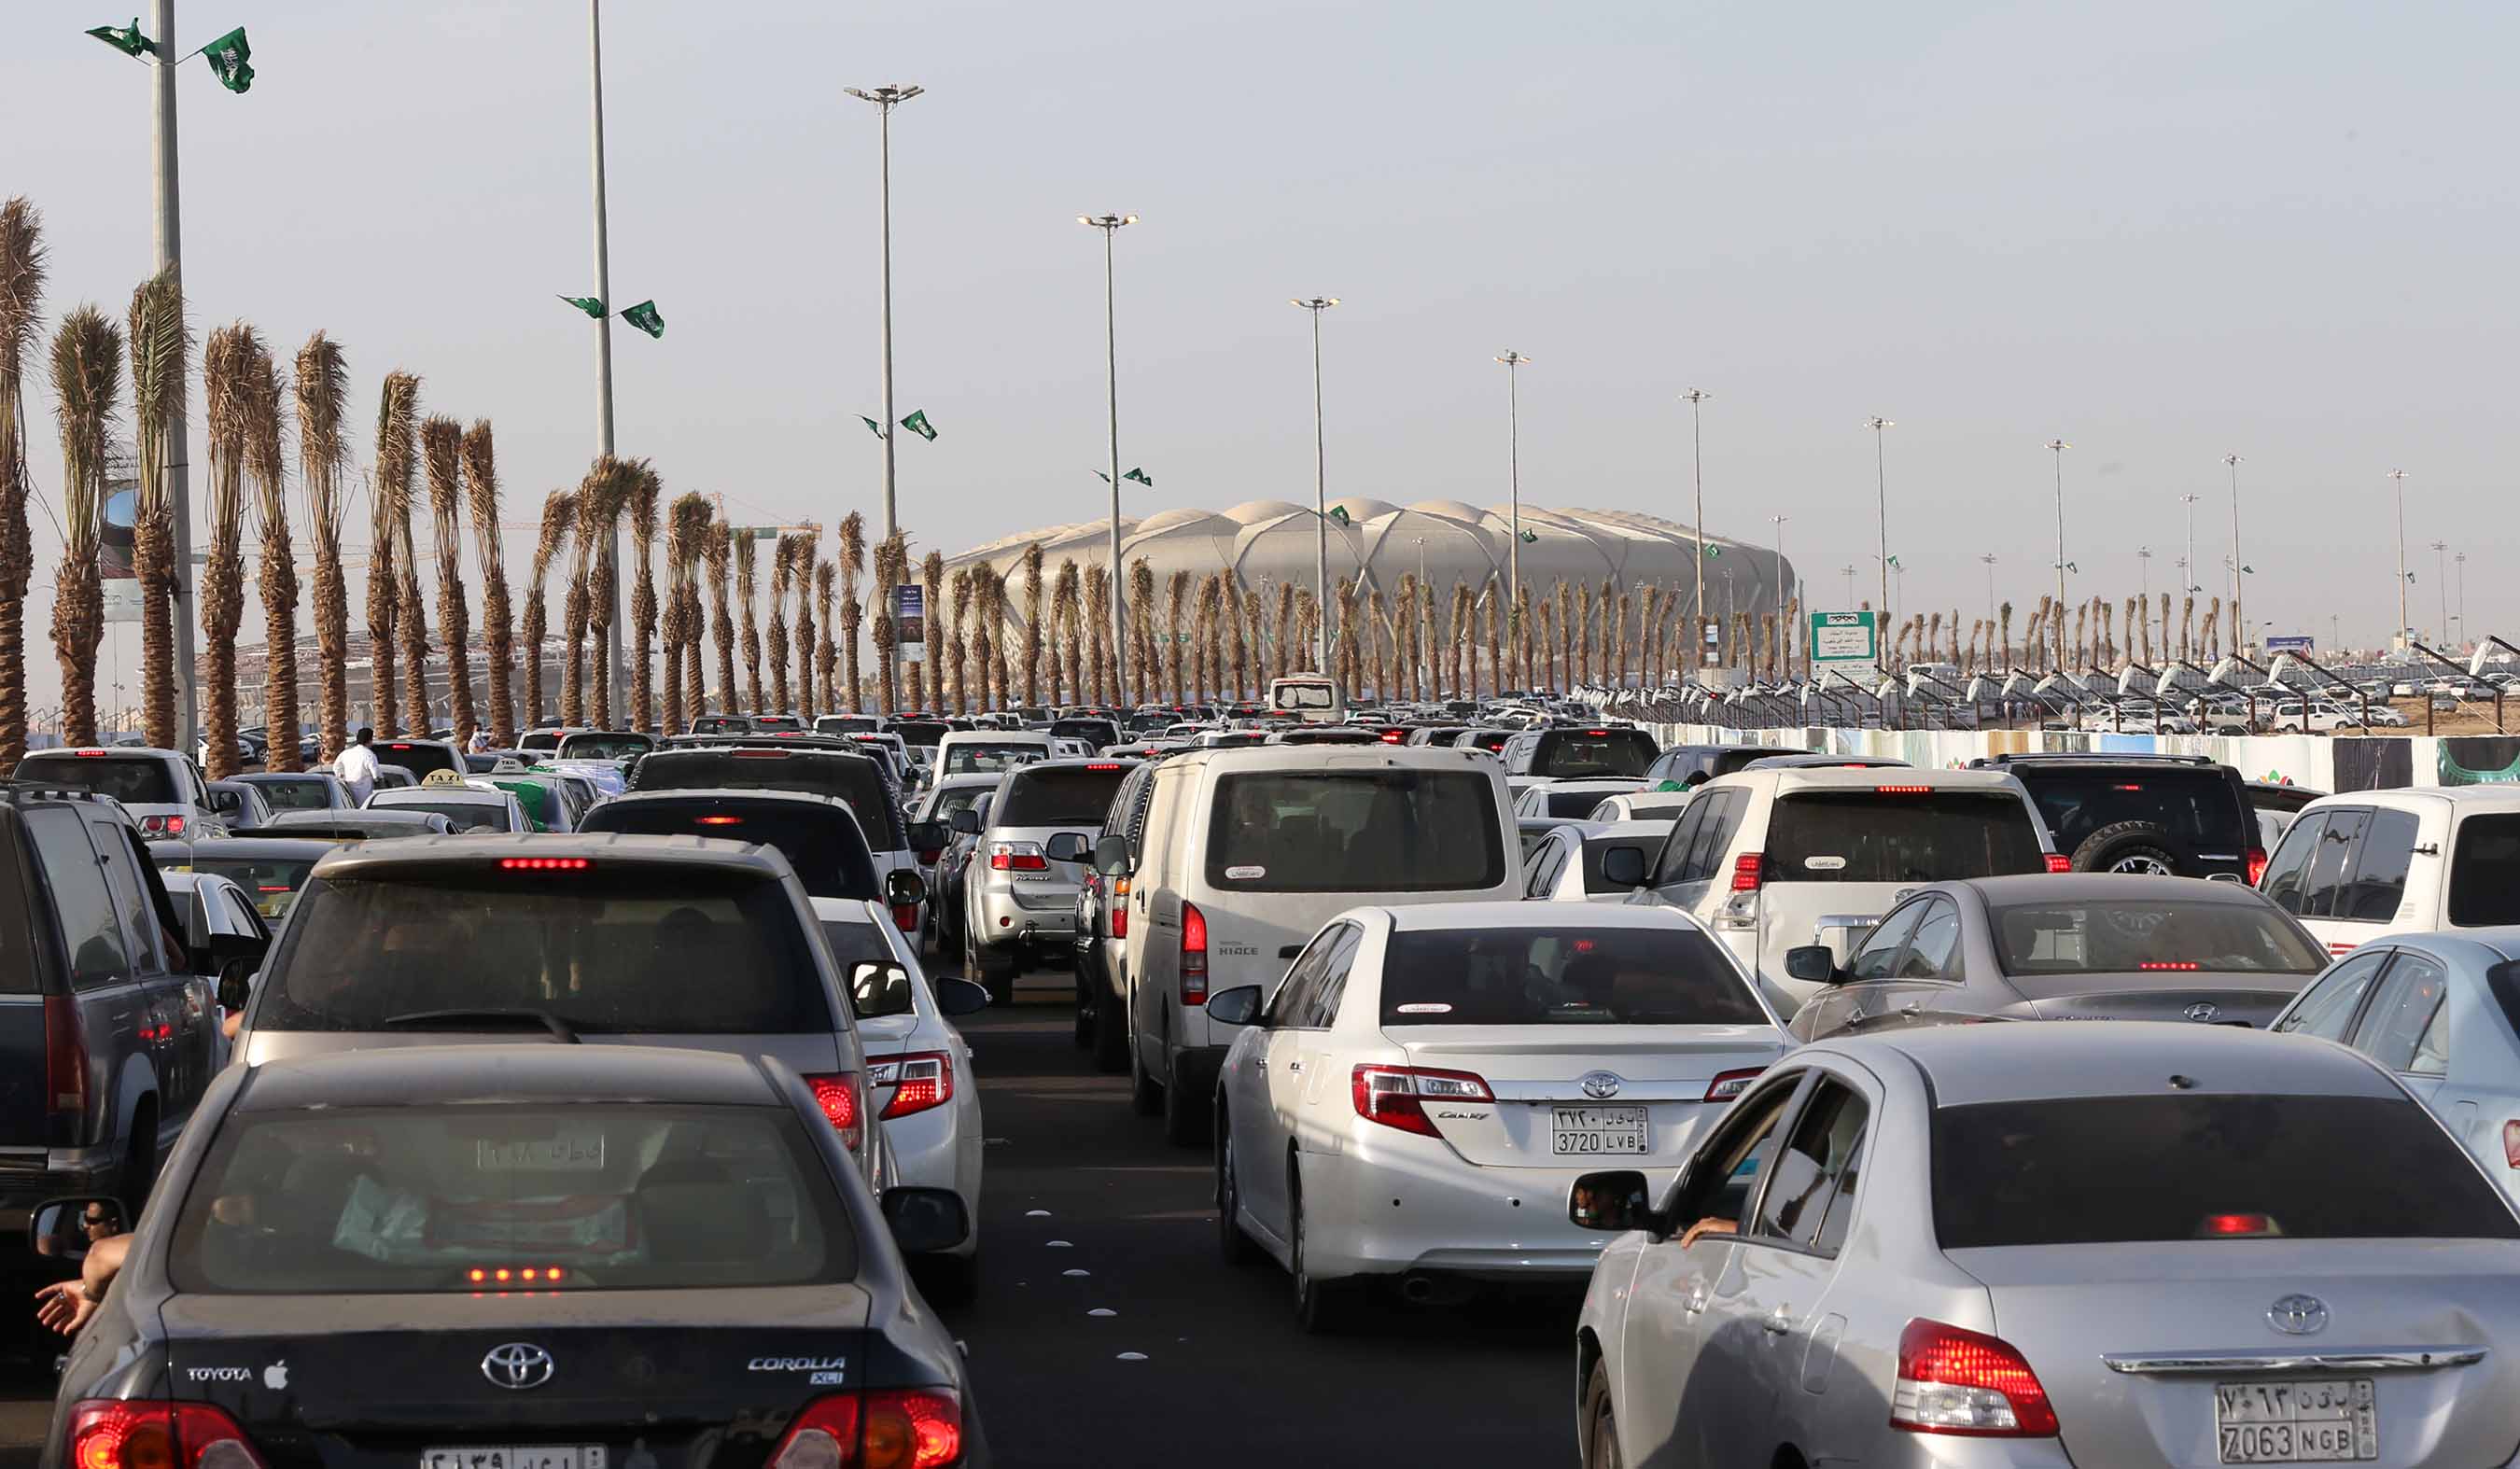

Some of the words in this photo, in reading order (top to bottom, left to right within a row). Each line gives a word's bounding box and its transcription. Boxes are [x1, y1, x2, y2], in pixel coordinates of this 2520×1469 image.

[1219, 947, 1259, 956] HIACE
[1558, 1133, 1599, 1152] 3720
[1605, 1136, 1635, 1149] LVB
[747, 1357, 847, 1371] COROLLA
[187, 1367, 253, 1381] TOYOTA
[2301, 1429, 2350, 1451] NGB
